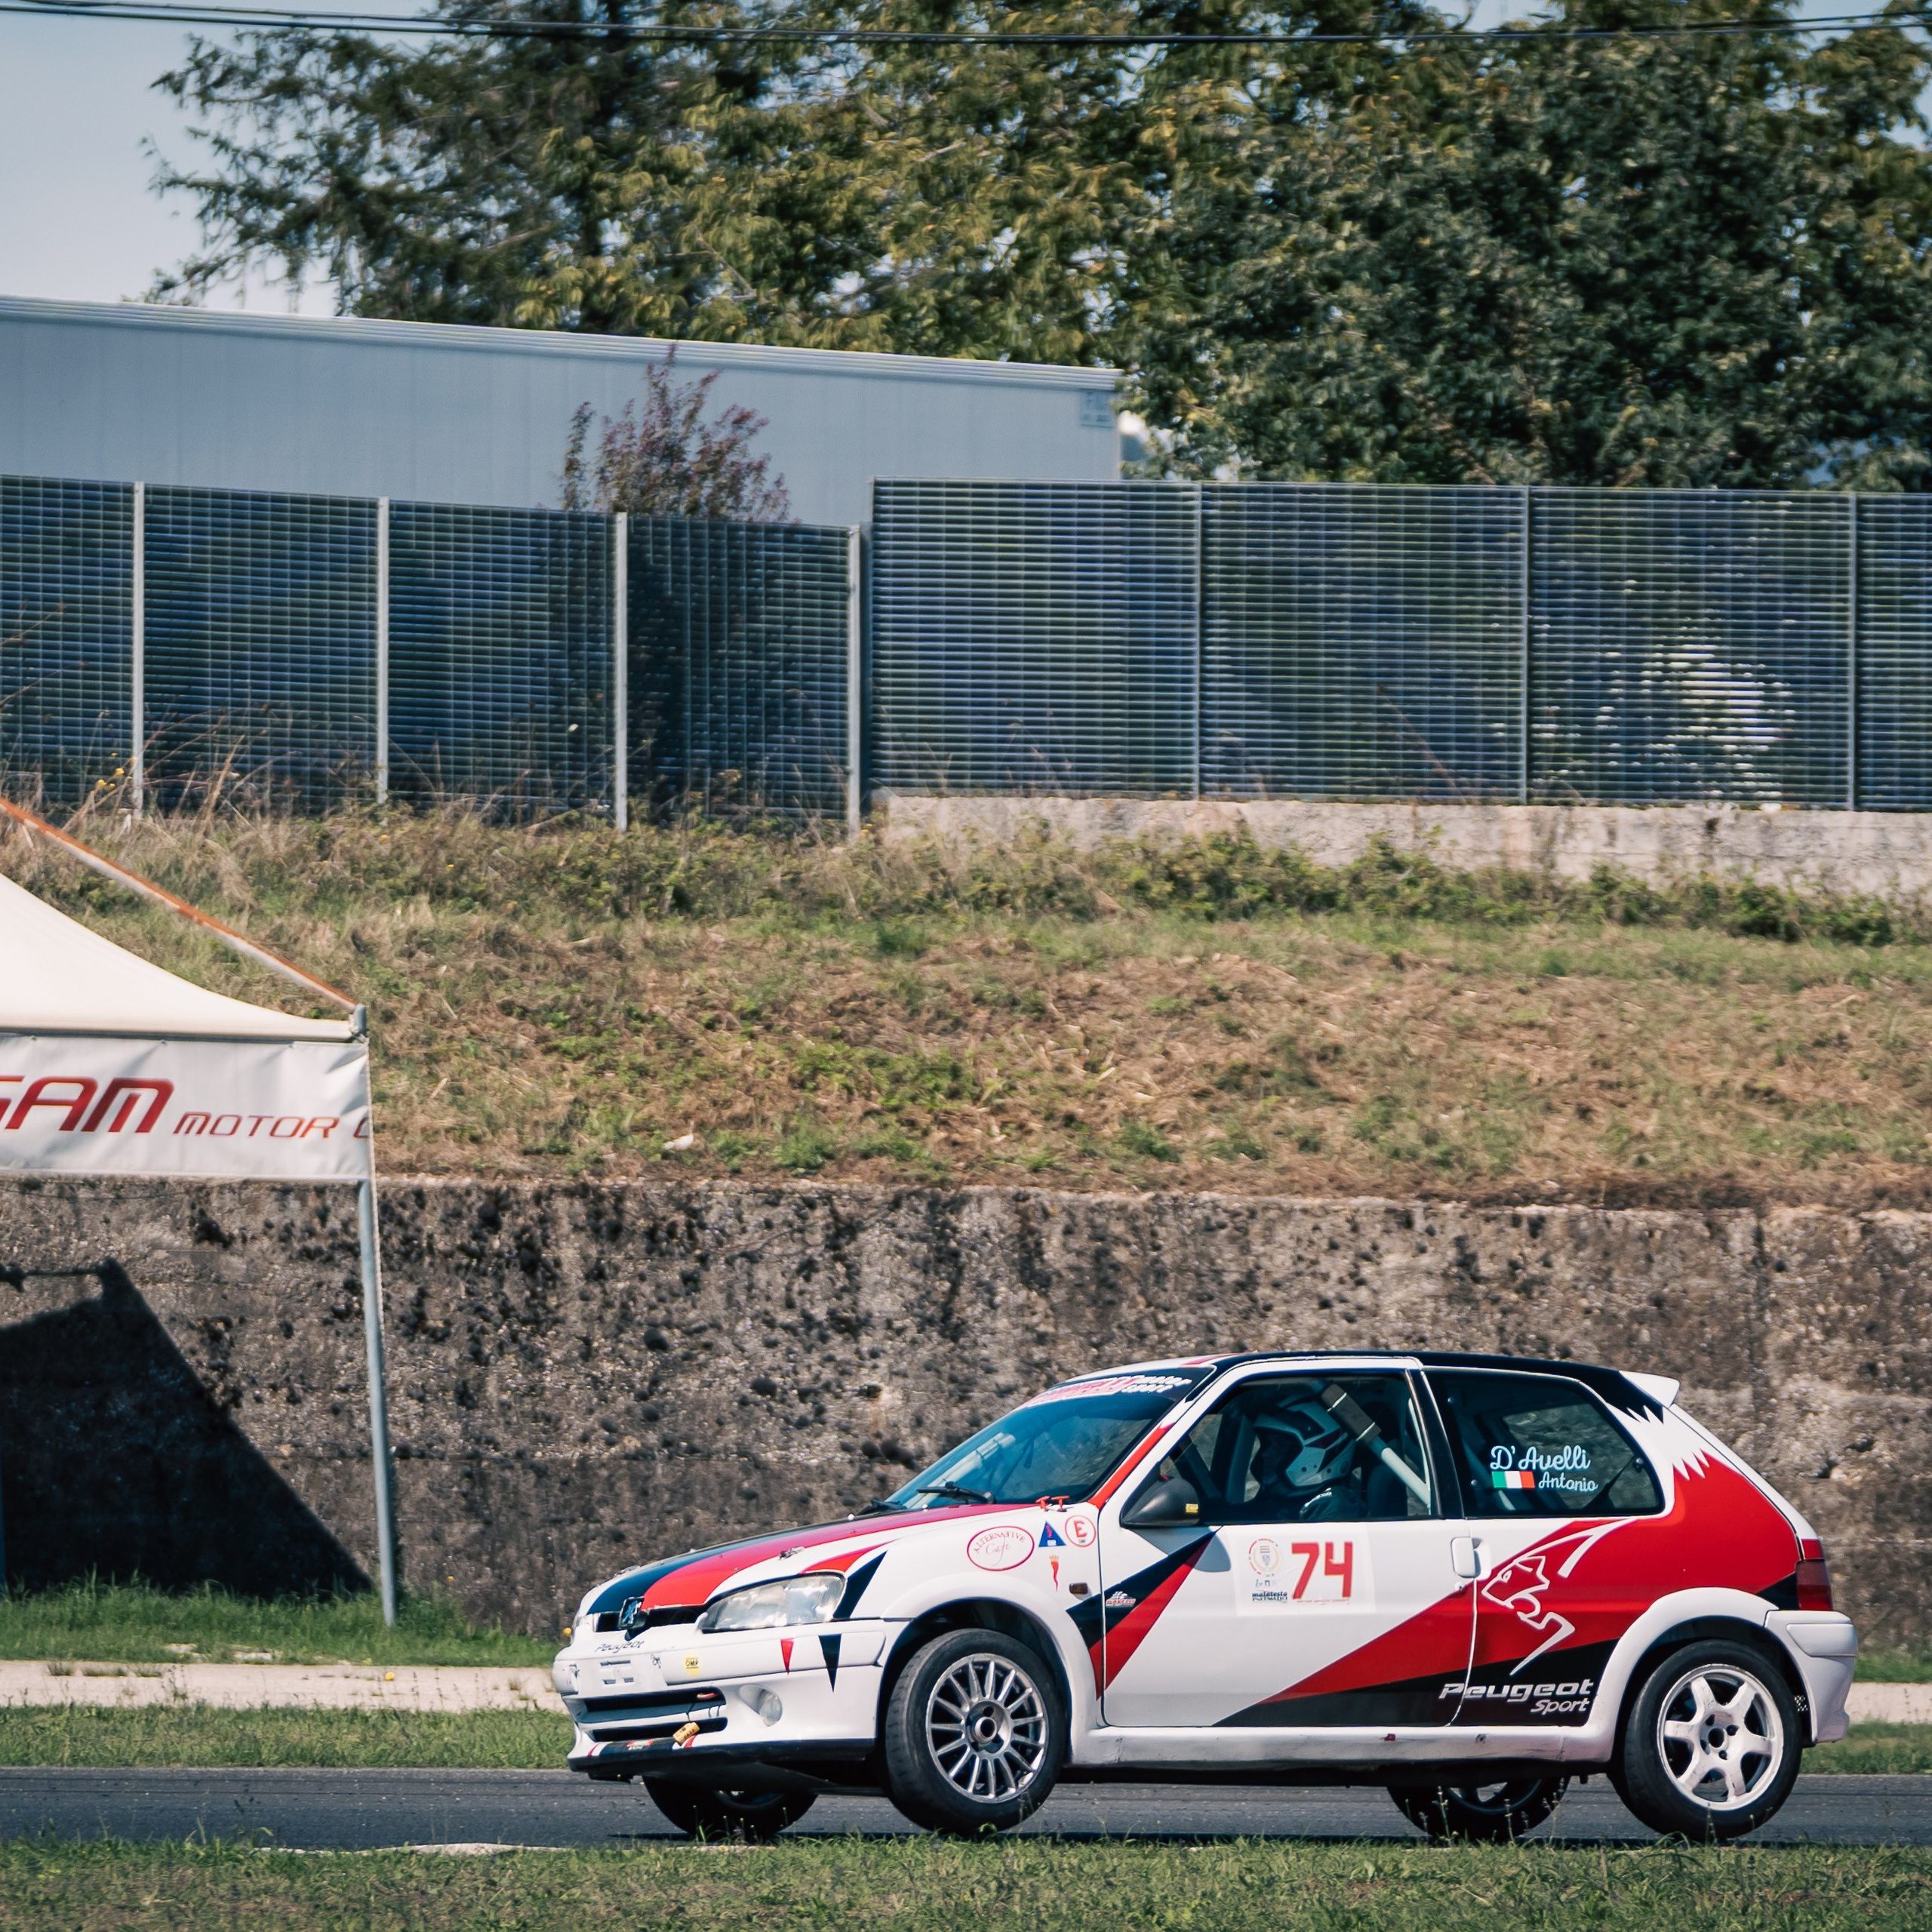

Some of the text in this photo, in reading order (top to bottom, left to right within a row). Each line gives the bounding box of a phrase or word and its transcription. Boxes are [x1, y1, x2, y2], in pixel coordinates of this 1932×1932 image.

[173, 1112, 340, 1139] MOTOR
[1538, 1471, 1598, 1492] Antonio
[974, 1530, 1026, 1554] ALTERNATIVE
[1291, 1541, 1353, 1599] 74
[595, 1641, 644, 1654] Peugeot
[1438, 1678, 1594, 1703] Peugeot
[1531, 1698, 1589, 1715] Sport
